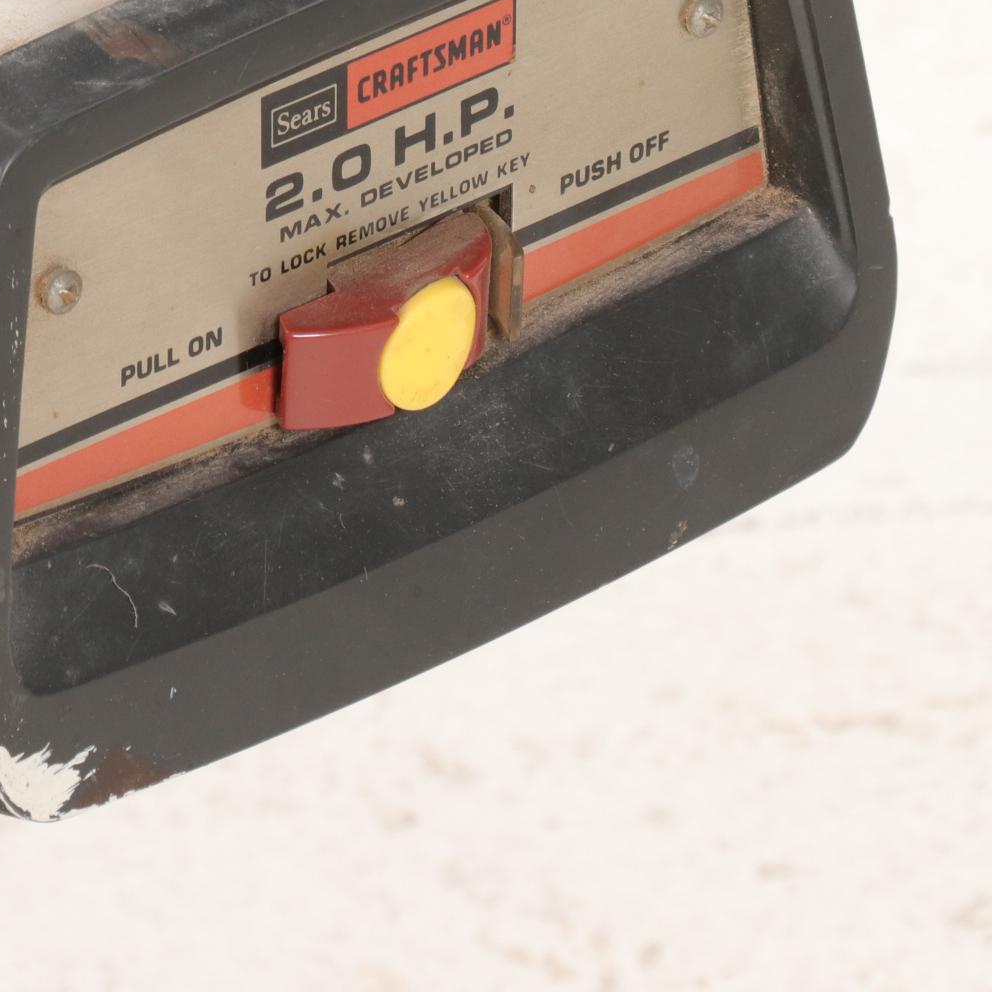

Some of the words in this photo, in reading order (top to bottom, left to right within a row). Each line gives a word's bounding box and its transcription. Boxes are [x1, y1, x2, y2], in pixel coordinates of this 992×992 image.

[265, 143, 372, 222] 2.0
[395, 87, 515, 166] H.P.
[277, 98, 331, 136] Sears
[280, 203, 350, 243] MAX.
[361, 129, 513, 207] DEVELOPED
[560, 154, 623, 196] PUSH
[629, 131, 670, 164] OFF
[249, 267, 271, 287] TO
[281, 243, 326, 274] LOCK
[336, 206, 409, 250] REMOVE
[419, 171, 488, 212] YELLOW
[497, 152, 531, 179] KEY
[120, 348, 180, 387] PULL
[188, 327, 223, 357] ON
